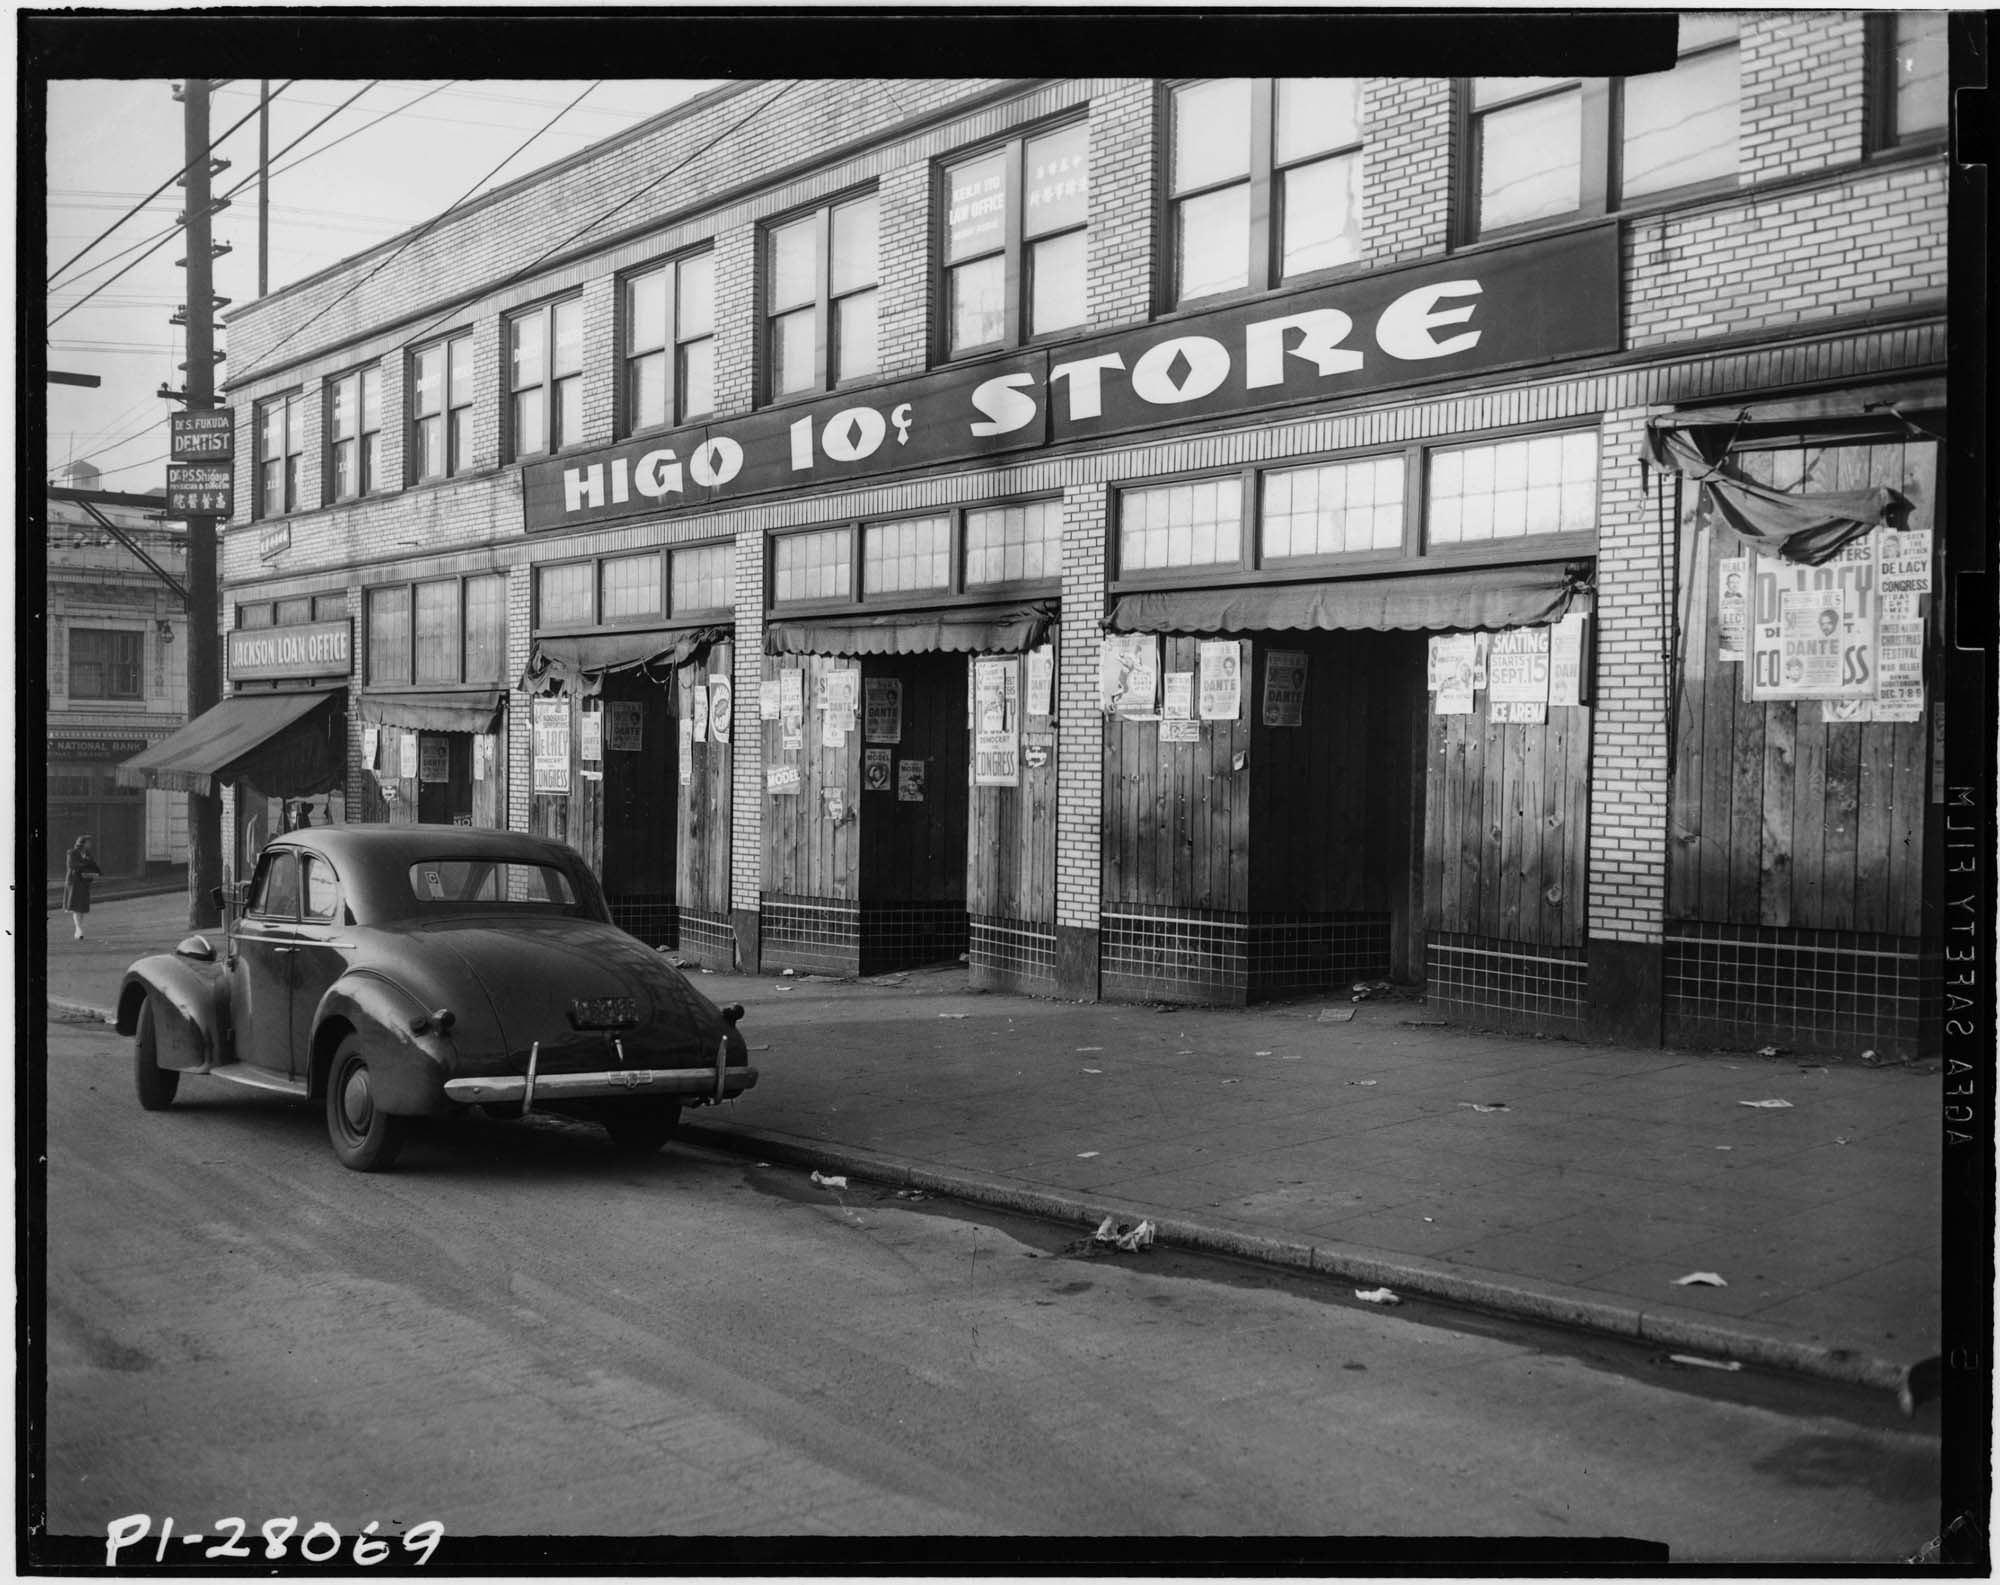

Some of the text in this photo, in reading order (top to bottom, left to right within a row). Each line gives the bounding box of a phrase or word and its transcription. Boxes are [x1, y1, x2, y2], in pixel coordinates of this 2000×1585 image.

[970, 192, 1006, 218] OFFICE
[564, 279, 1483, 513] HIGO 10¢ STORE
[195, 416, 229, 429] FUKUDA
[175, 432, 230, 452] DENTIST
[1882, 560, 1928, 575] DE LACY
[1881, 578, 1929, 592] CONGRESS
[1493, 632, 1549, 653] SKATING
[1881, 634, 1921, 646] CHRISTMAS
[233, 631, 347, 667] JACKSON LOAN OFFICE
[1786, 640, 1839, 656] DANTE
[1881, 648, 1919, 660] FESTIVAL
[1491, 655, 1525, 667] STARTS
[1899, 662, 1921, 671] RELIEF
[1491, 655, 1548, 684] SEPT. 15
[1203, 678, 1237, 692] DANTE
[1268, 689, 1303, 704] DANTE
[869, 706, 898, 718] DANTE
[1491, 702, 1507, 724] ICE
[57, 742, 143, 751] NATIONAL BANK
[867, 754, 889, 762] MODEL
[977, 752, 1015, 777] CONGRESS
[535, 769, 568, 788] CONGRESS
[767, 769, 800, 787] MODEL
